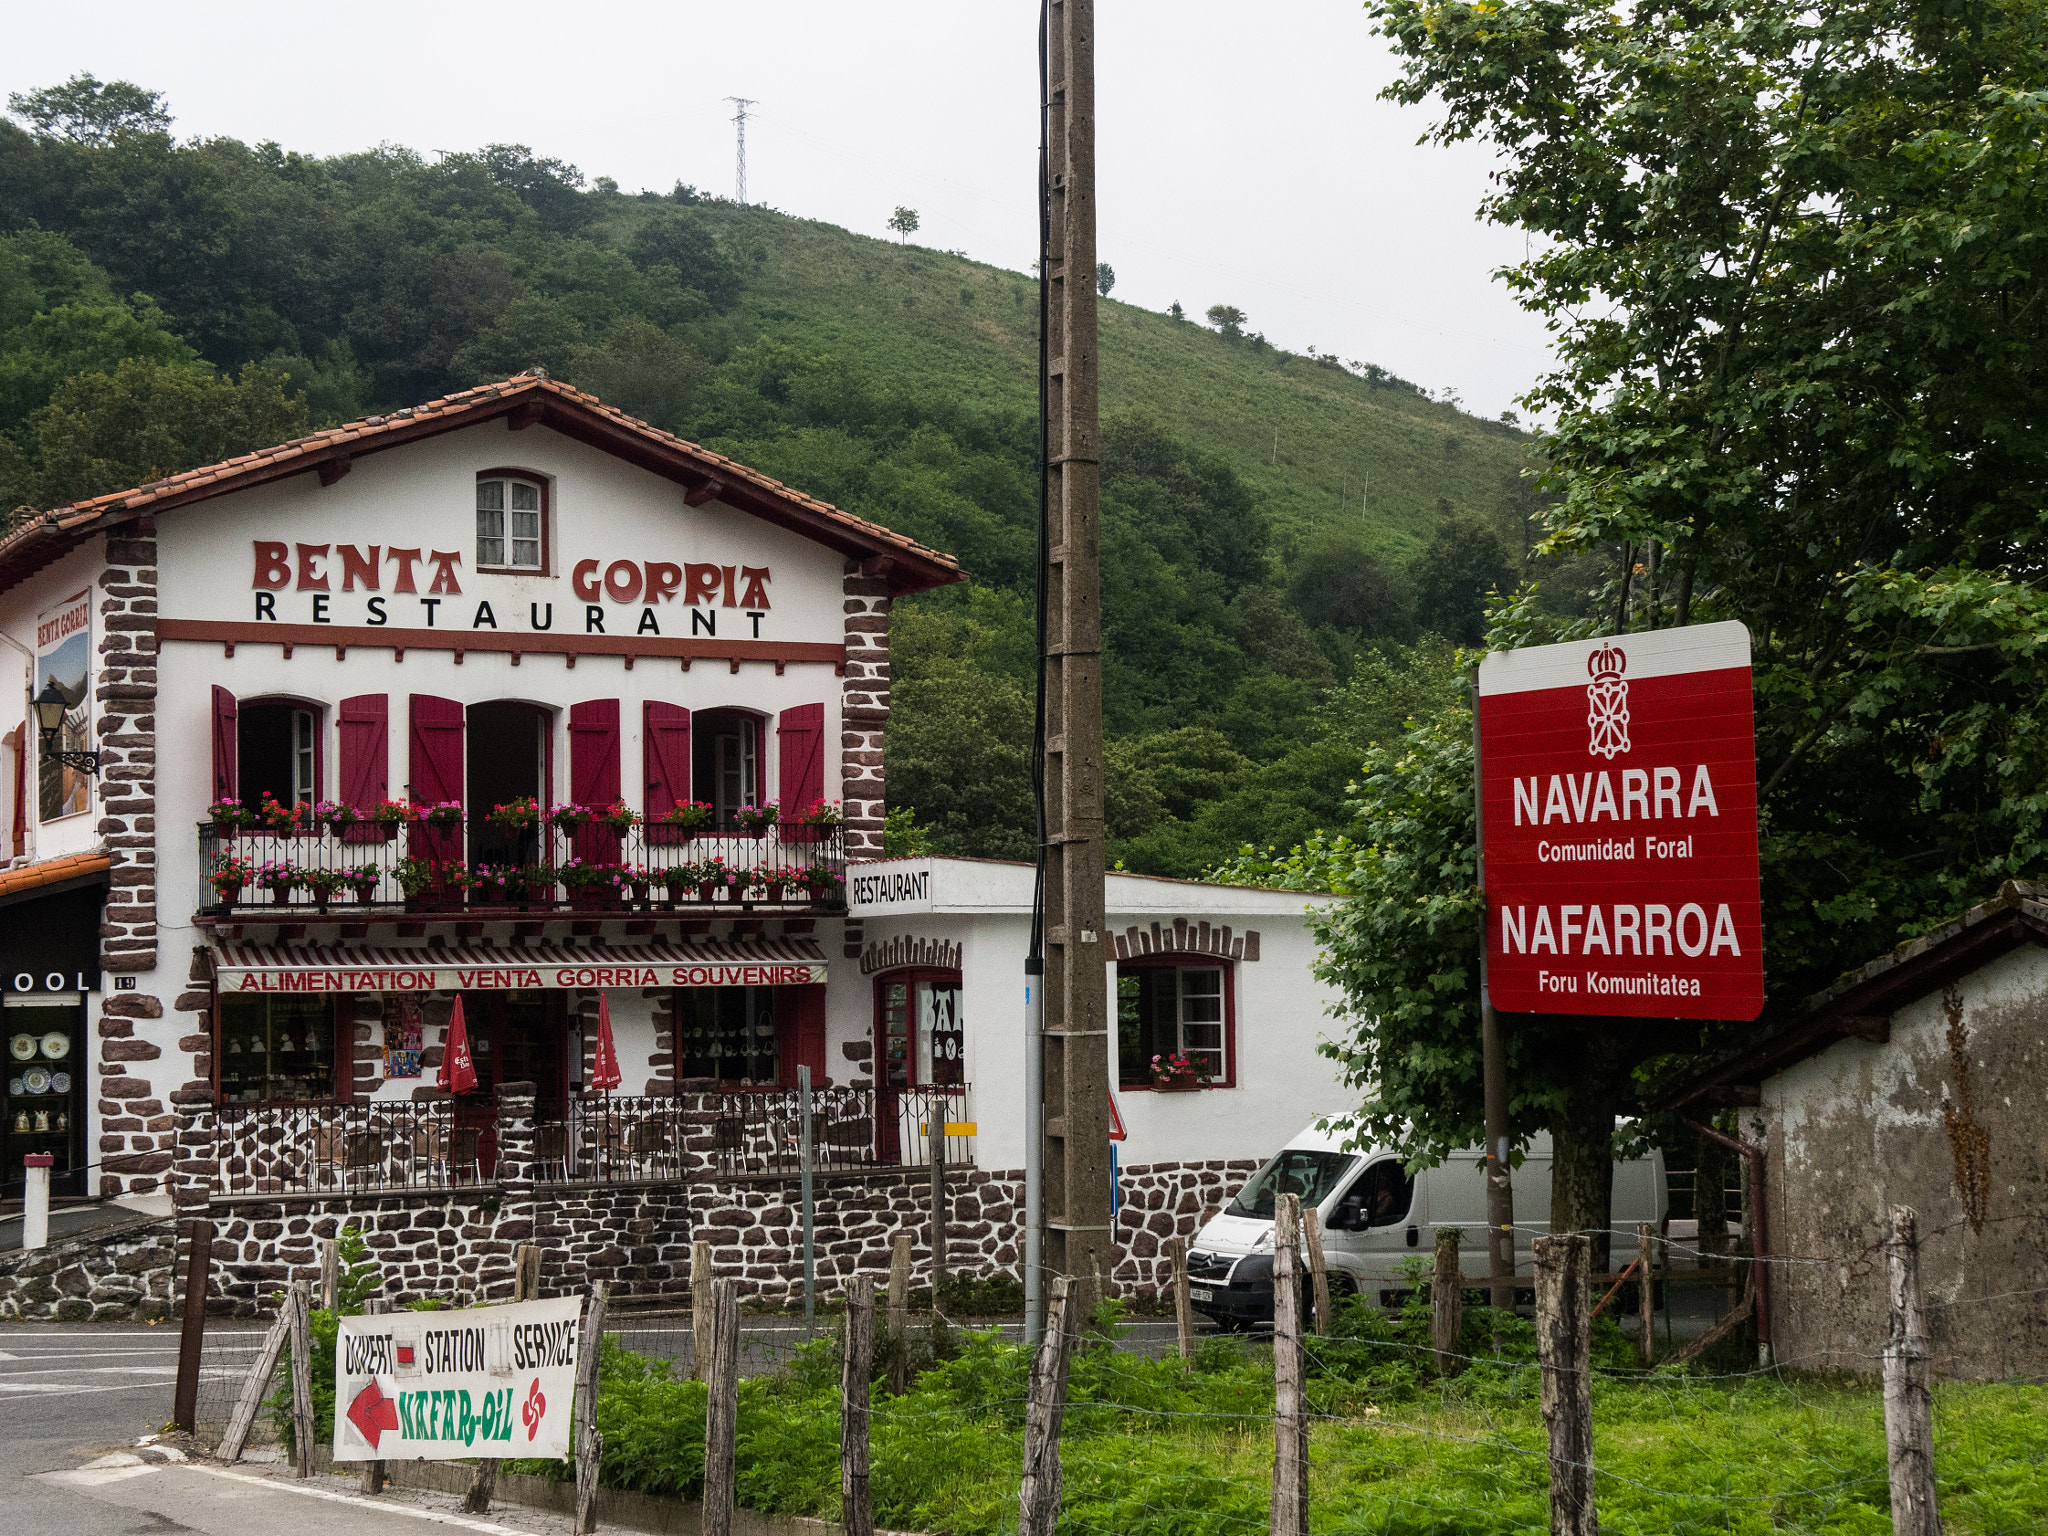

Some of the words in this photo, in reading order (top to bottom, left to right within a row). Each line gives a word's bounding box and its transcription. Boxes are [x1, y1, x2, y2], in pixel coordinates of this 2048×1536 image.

[252, 540, 462, 595] BENTA
[572, 558, 771, 609] GORRIA
[38, 617, 60, 648] BENTA
[61, 602, 88, 637] GORRIA
[255, 591, 766, 639] RESTAURANT
[1513, 764, 1719, 827] NAVARRA
[1538, 837, 1635, 863] Comunidad
[1645, 835, 1693, 859] Foral
[853, 871, 929, 905] RESTAURANT
[1501, 902, 1742, 958] NAFARROA
[116, 978, 135, 989] 19
[239, 970, 436, 992] ALIMENTATION
[457, 969, 543, 990] VENTA
[555, 967, 660, 988] GORRIA
[672, 965, 812, 986] SOUVENIRS
[1539, 970, 1578, 993] Foru
[1586, 971, 1701, 997] Komunitatea
[345, 1333, 394, 1375] OUVERT
[425, 1327, 485, 1374] STATION
[513, 1318, 577, 1370] SERVICE
